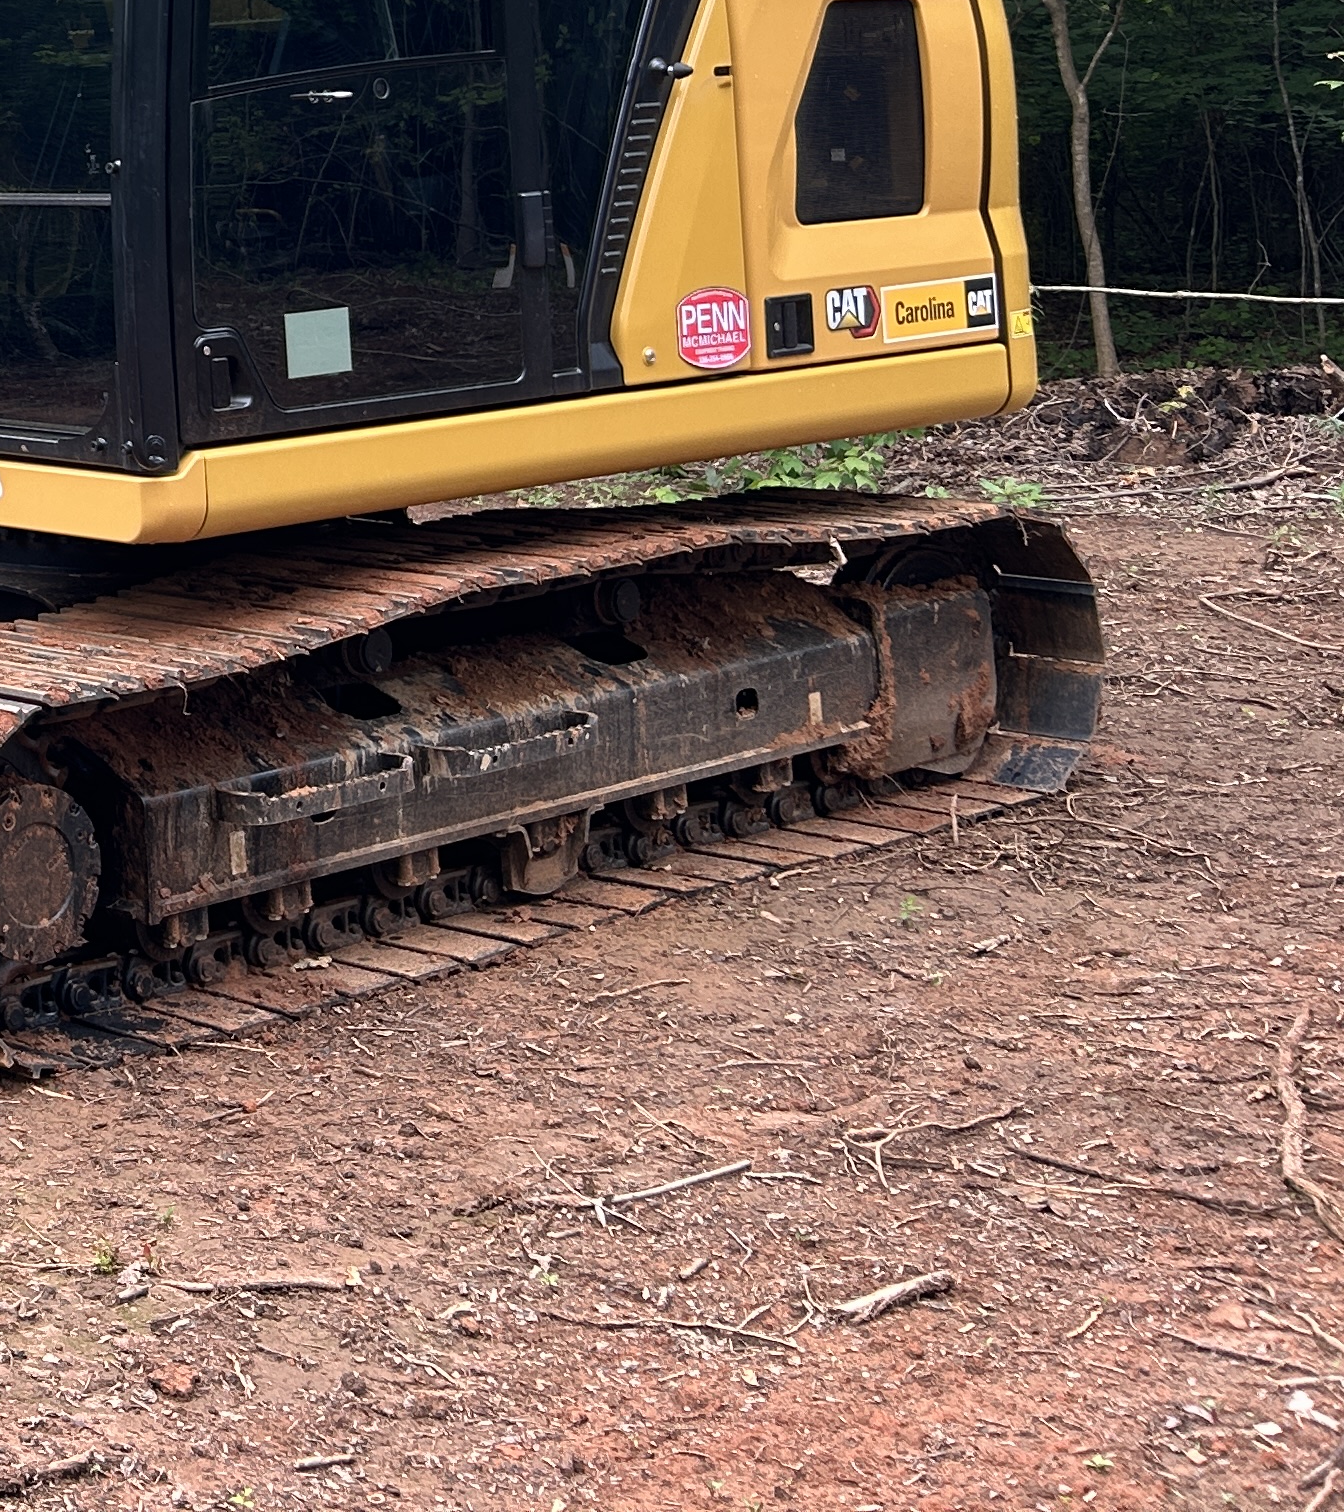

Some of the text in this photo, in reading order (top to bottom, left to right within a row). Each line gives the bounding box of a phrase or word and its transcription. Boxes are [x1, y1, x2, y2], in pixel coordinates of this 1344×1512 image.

[681, 299, 746, 336] PENN
[826, 287, 868, 330] CAT
[895, 296, 955, 325] Carolina
[967, 289, 993, 317] CAT
